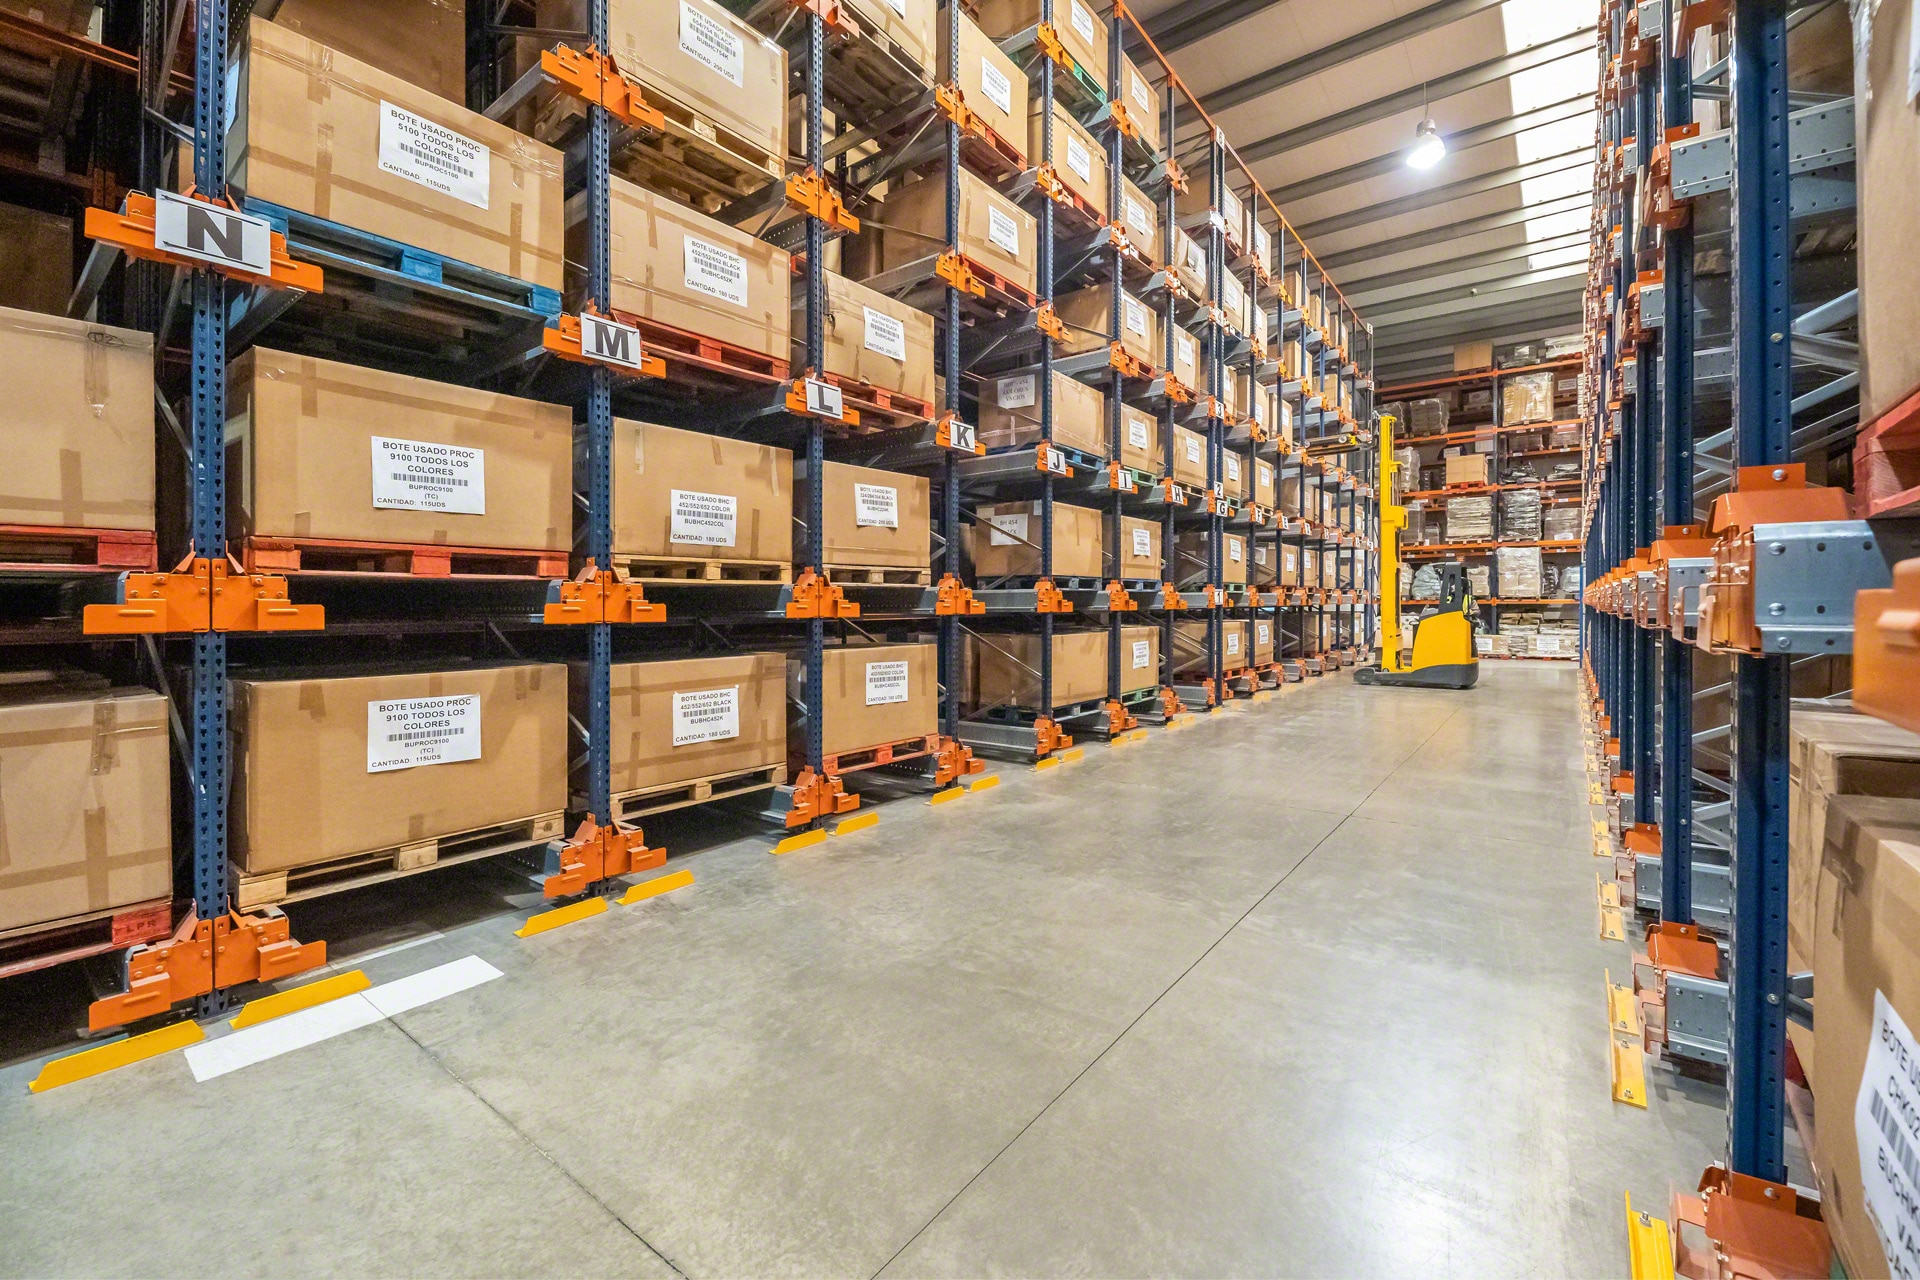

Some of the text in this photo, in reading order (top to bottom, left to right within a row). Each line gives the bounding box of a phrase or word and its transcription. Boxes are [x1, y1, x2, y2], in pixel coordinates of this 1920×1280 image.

[688, 7, 736, 43] BOTE USADO BHC
[714, 32, 732, 47] BLACK
[682, 43, 712, 65] CANTIDAD:
[724, 69, 734, 80] UDS
[391, 110, 480, 153] BOTE USADO PROC
[398, 123, 474, 159] 5100 TODOS LOS
[415, 140, 459, 162] COLORES
[415, 159, 458, 178] BUPROC5100
[383, 162, 450, 192] CANTIDAD: 115UDS
[187, 206, 242, 261] N
[692, 241, 740, 263] BOTE USADO BHC
[692, 249, 740, 271] 452/552/652 BLACK
[701, 268, 733, 283] BUBHC452K
[687, 279, 717, 293] CANTIDAD:
[728, 294, 739, 302] UDS
[595, 322, 629, 360] M
[818, 385, 833, 412] L
[956, 425, 970, 448] K
[383, 442, 474, 458] BOTE USADO PROC
[390, 453, 468, 468] 9100 TODOS LOS
[1053, 453, 1060, 469] J
[408, 465, 454, 476] COLORES
[409, 484, 453, 492] BUPROC9100
[1175, 487, 1181, 501] H
[679, 502, 710, 510] 452/552/652
[1220, 502, 1225, 514] G
[685, 519, 724, 527] BUBHC452COL
[380, 698, 471, 712] BOTE USADO PROC
[681, 702, 712, 710] 452/552/652
[411, 711, 445, 719] TODOS
[691, 716, 724, 724] BUBHC452K
[404, 720, 450, 730] COLORES
[405, 738, 449, 748] BUPROC9100
[372, 758, 411, 768] CANTIDAD:
[1882, 1020, 1908, 1072] BOTE
